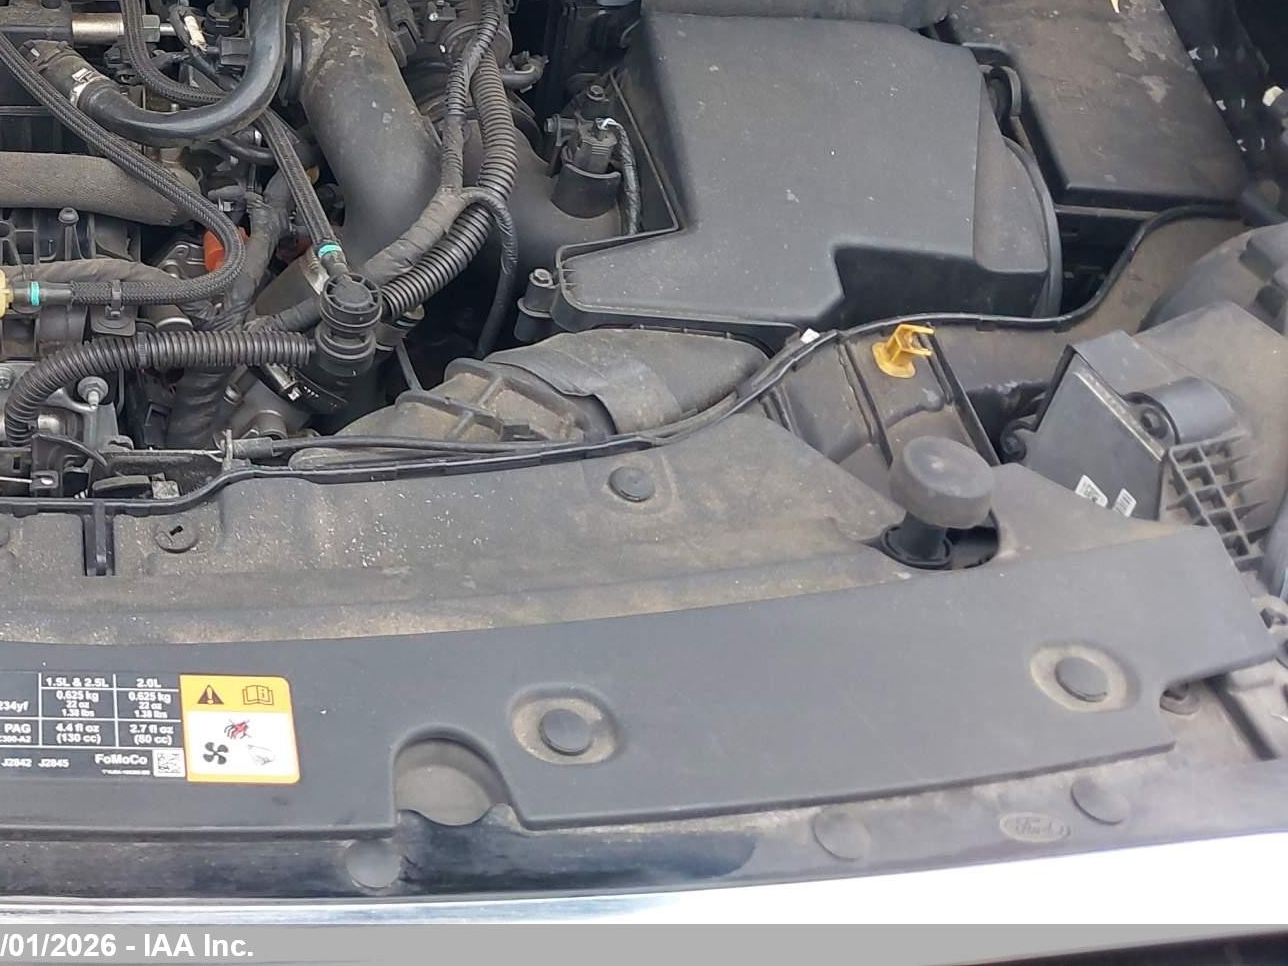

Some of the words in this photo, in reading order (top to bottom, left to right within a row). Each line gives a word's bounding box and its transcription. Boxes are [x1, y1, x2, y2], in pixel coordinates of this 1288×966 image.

[46, 677, 70, 687] 1.5L
[72, 677, 82, 687] &
[84, 677, 109, 688] 2.5L
[136, 678, 162, 688] 2.0L
[55, 690, 84, 700] 0.625
[85, 690, 99, 703] kg
[128, 691, 156, 702] 0.625
[158, 692, 172, 704] kg
[81, 709, 95, 717] lbs
[153, 710, 168, 718] lbs
[4, 723, 32, 734] PAG
[55, 723, 73, 733] 4.4
[74, 723, 83, 733] fl
[85, 725, 100, 733] oz
[129, 724, 148, 734] 2.7
[148, 724, 158, 734] fl
[159, 726, 174, 734] oz
[56, 733, 81, 745] (130
[82, 733, 102, 745] cc)
[153, 734, 173, 746] cc)
[94, 753, 148, 765] FoMoCo
